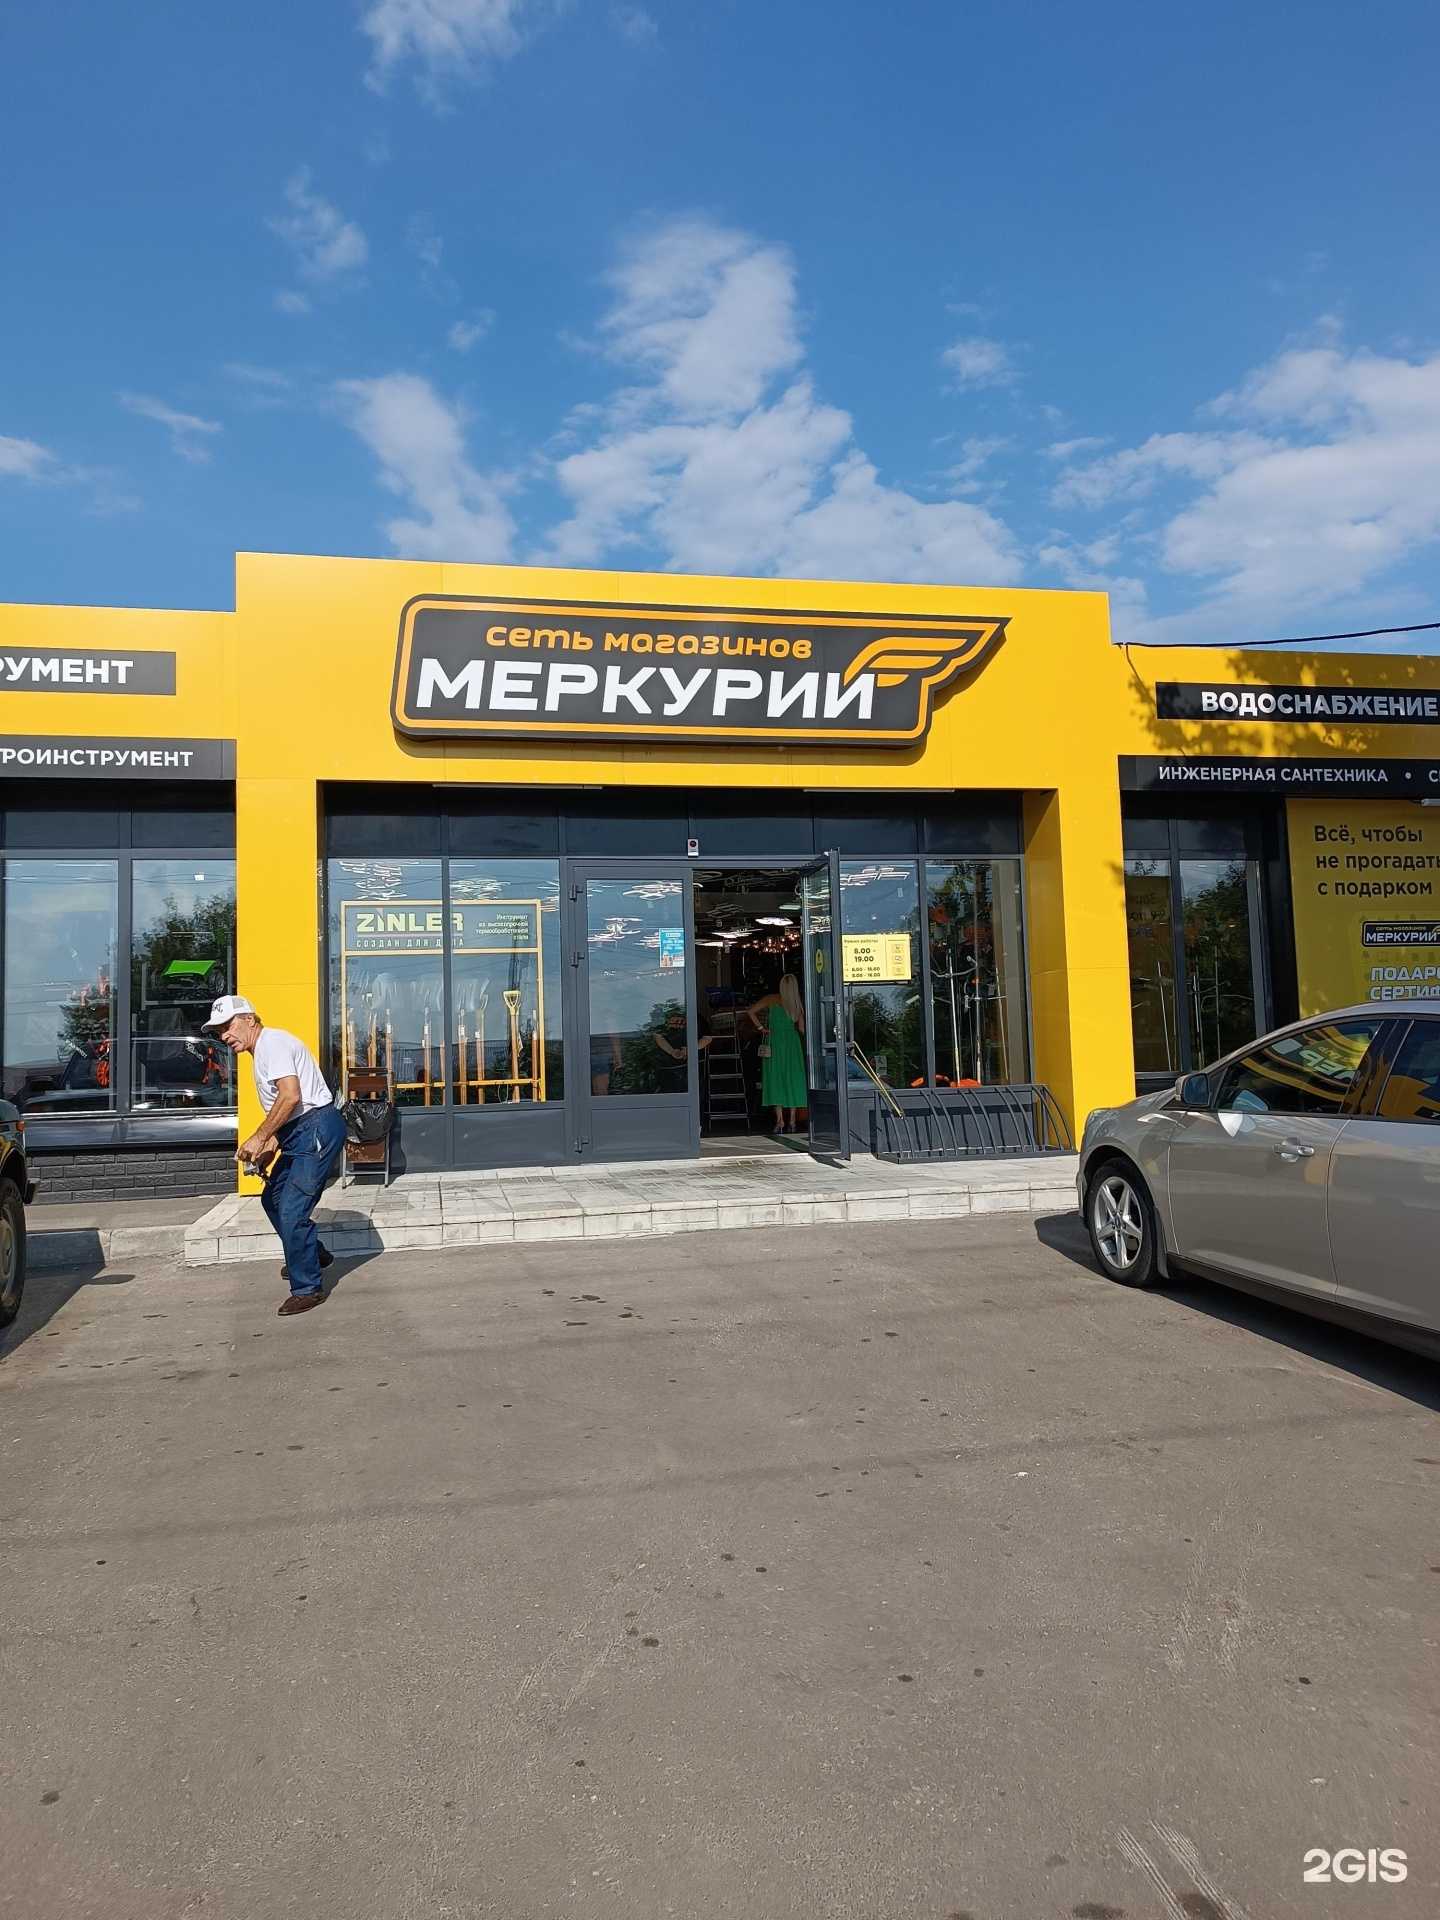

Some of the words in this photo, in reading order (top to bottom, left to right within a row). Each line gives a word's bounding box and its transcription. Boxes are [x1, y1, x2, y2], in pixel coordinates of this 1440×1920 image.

[486, 626, 593, 649] сеть
[603, 633, 813, 660] магазинов
[0, 656, 135, 684] УМЕНТ
[1200, 690, 1439, 718] ВОДОСНАБЖЕНИЕ
[0, 747, 194, 767] РОИНСТРУМЕНТ
[1158, 765, 1276, 781] ИНЖЕНЕРНАЯ
[1280, 767, 1389, 783] САНТЕХНИКА
[1428, 769, 1440, 783] С
[1314, 824, 1356, 846] Всё,
[1361, 825, 1423, 842] чтобы
[1316, 855, 1339, 869] не
[1317, 882, 1328, 896] с
[1334, 881, 1433, 899] подарком
